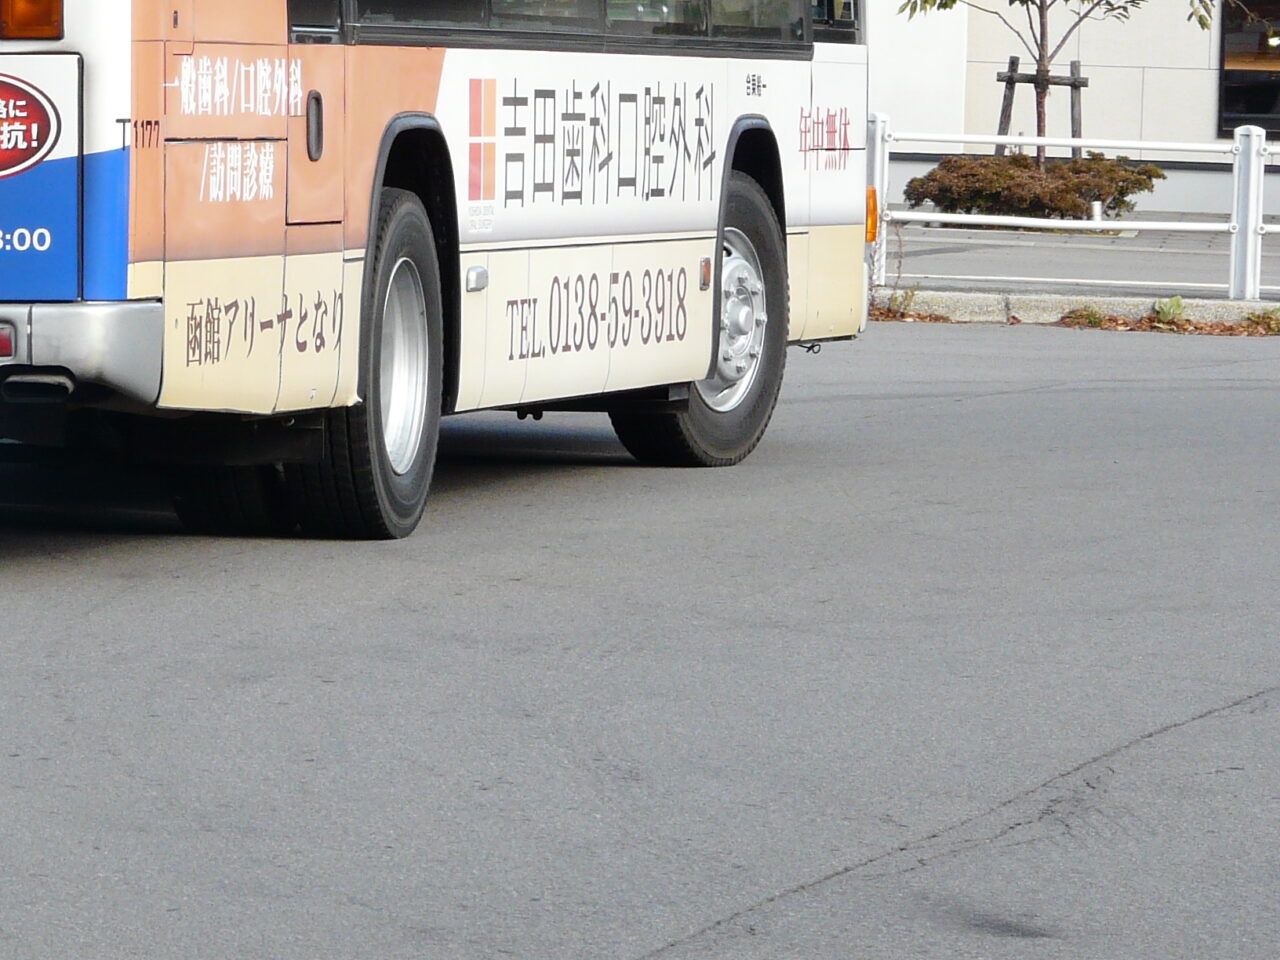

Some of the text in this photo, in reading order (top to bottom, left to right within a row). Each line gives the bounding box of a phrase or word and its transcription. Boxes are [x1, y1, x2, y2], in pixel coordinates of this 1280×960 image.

[162, 56, 303, 116] 一般歯科/口腔外科
[502, 78, 716, 208] 吉田歯科口腔外科
[799, 106, 851, 171] 年中無休
[186, 289, 344, 367] 函館アリーナとなり
